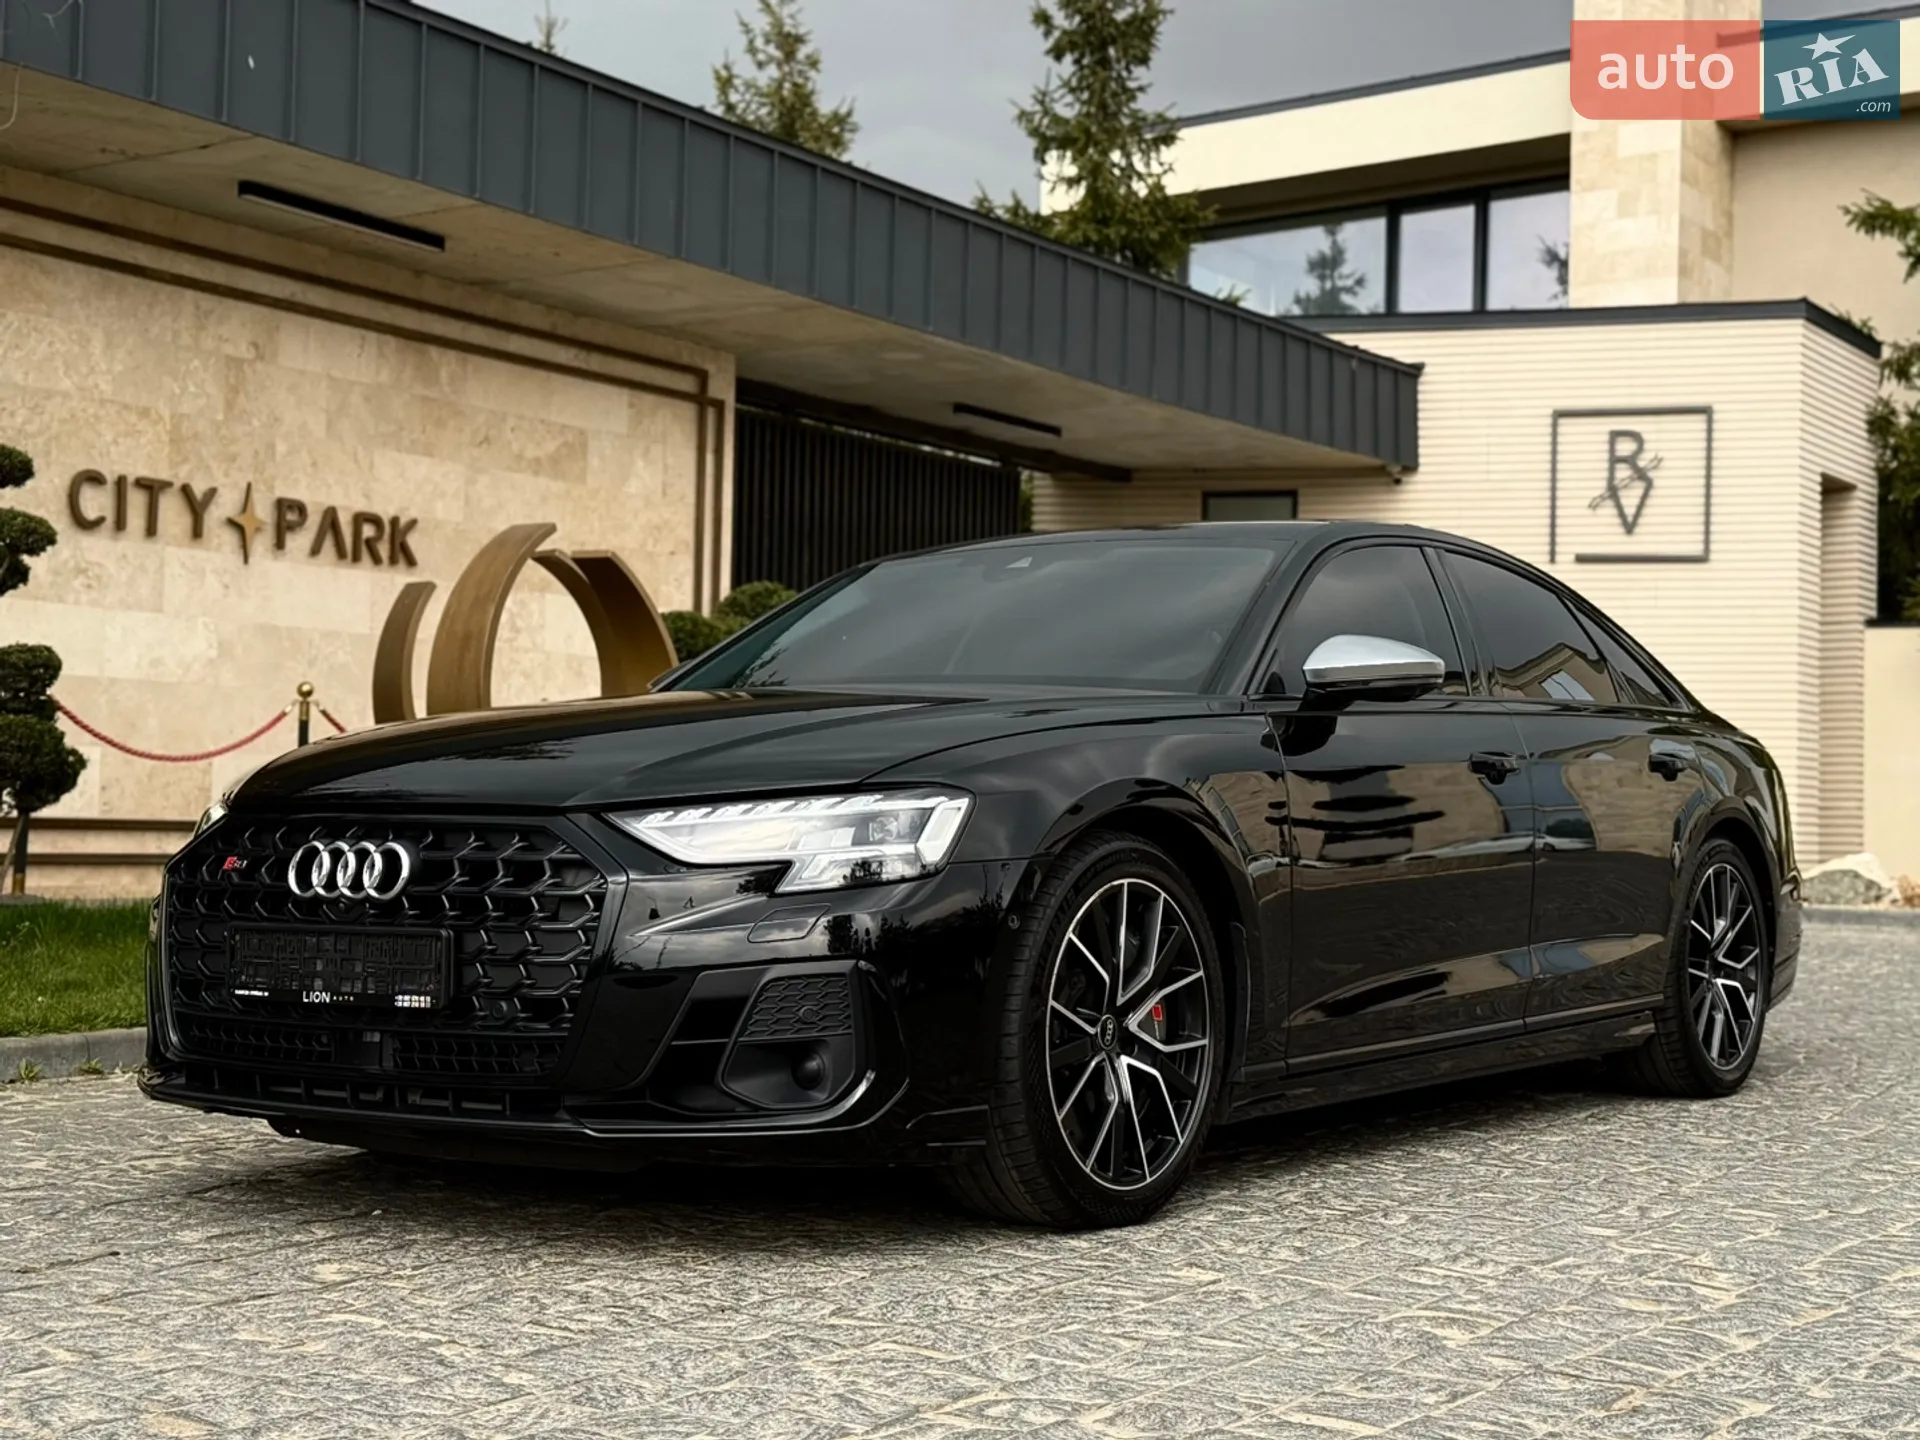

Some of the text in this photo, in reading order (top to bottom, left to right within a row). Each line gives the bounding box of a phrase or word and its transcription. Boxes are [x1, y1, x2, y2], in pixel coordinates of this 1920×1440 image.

[67, 469, 418, 568] CITY PARK
[303, 991, 331, 1003] LION
